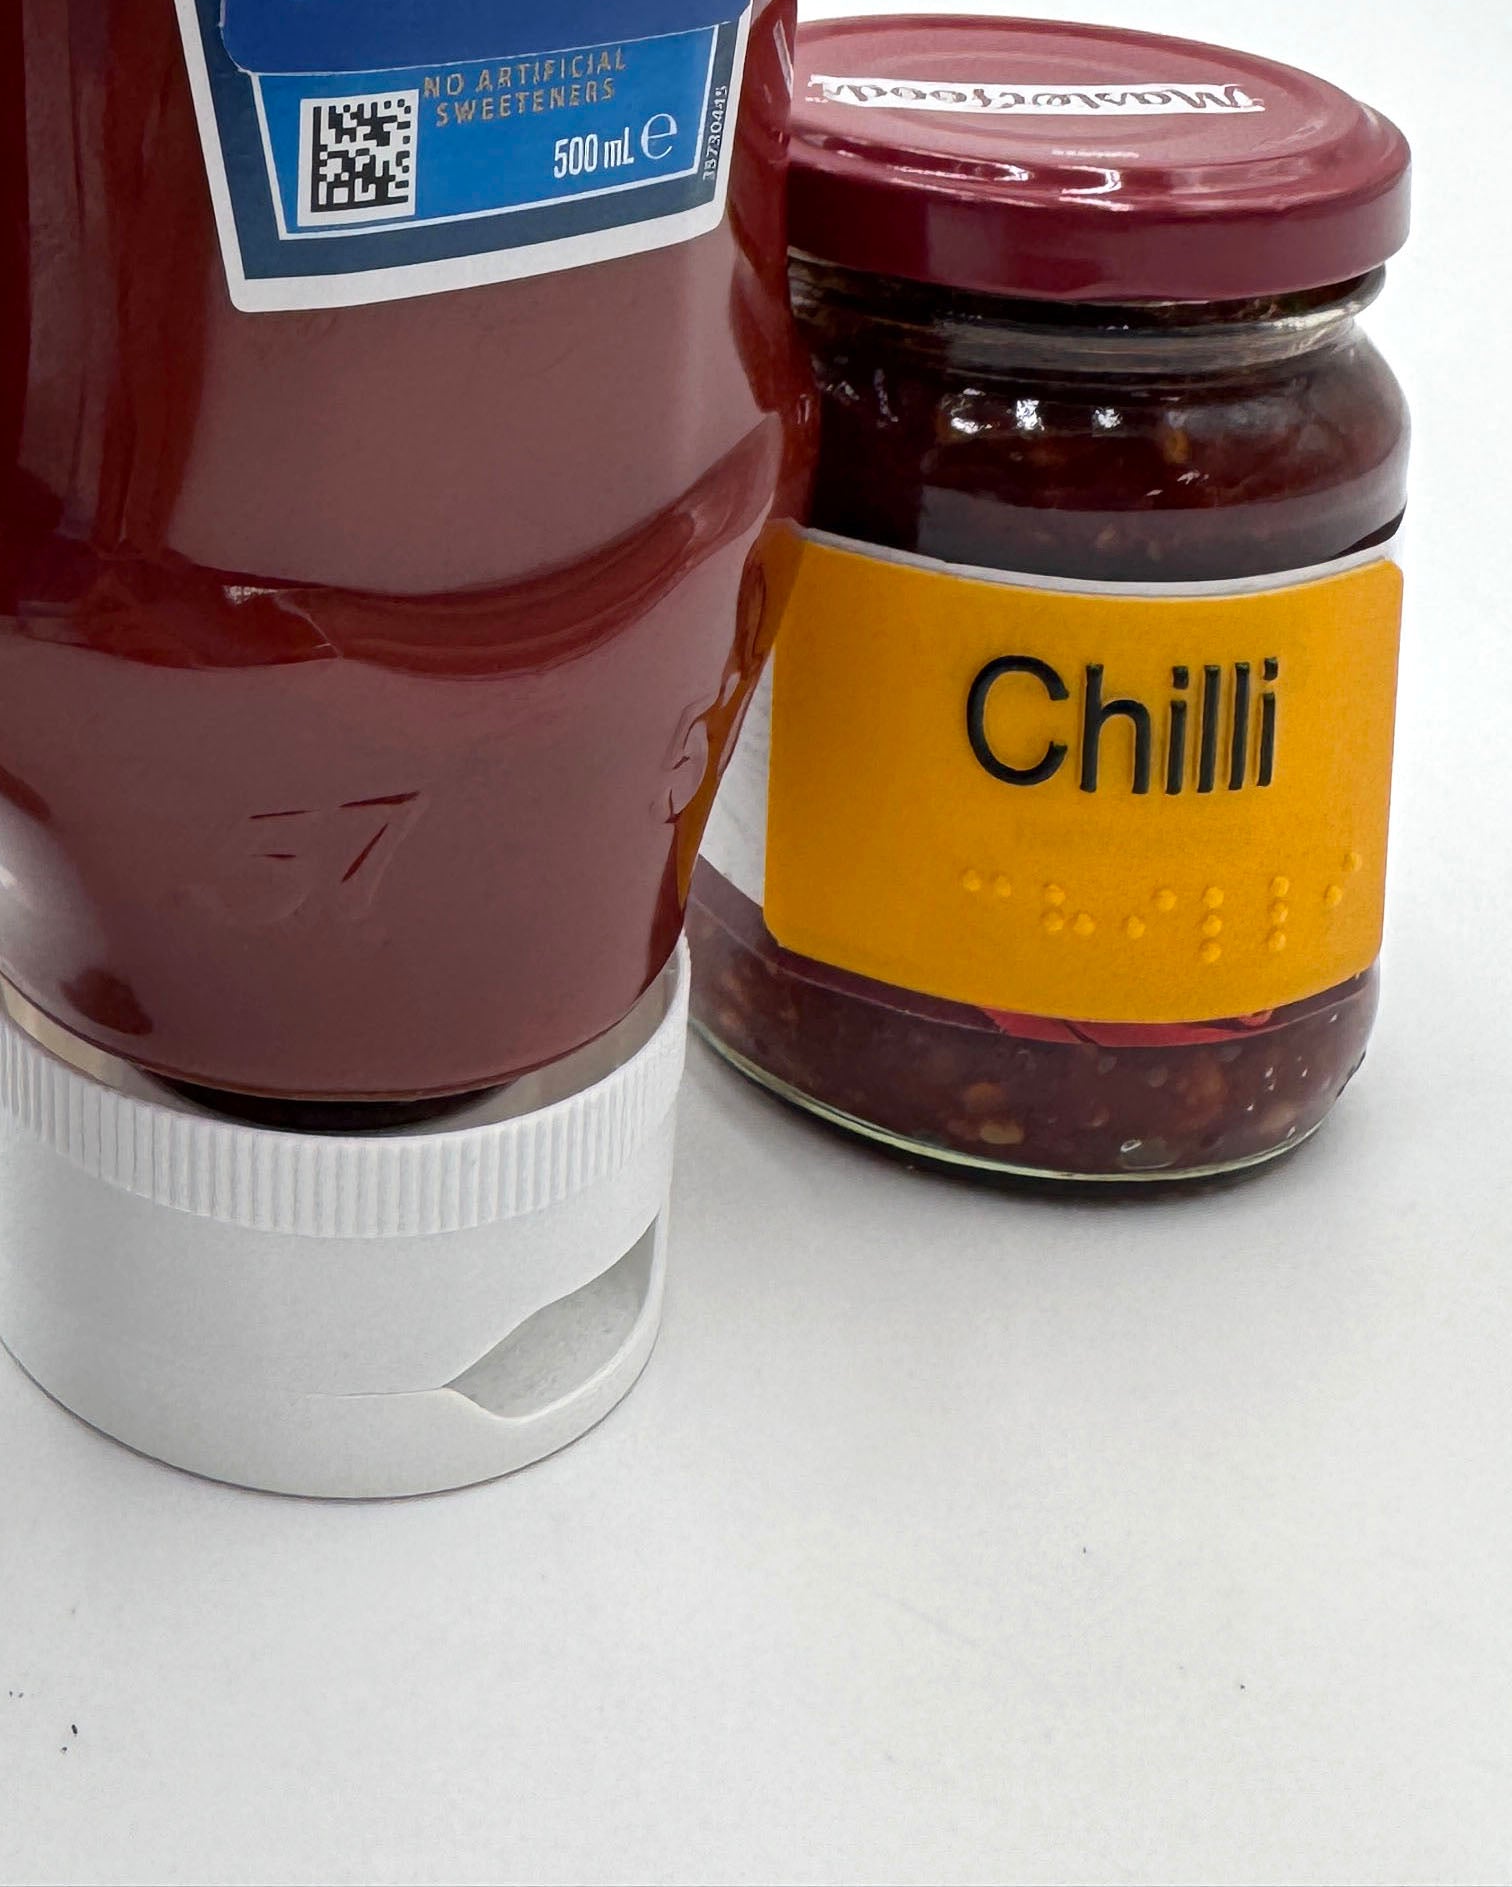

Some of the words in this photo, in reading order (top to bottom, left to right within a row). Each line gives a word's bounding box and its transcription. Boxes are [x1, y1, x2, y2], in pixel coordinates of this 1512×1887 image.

[423, 73, 465, 98] NO
[475, 47, 626, 93] ARTIFICIAL
[436, 77, 616, 128] SWEETENERS
[553, 133, 598, 179] 500
[604, 126, 634, 169] mL
[966, 655, 1279, 796] Chilli
